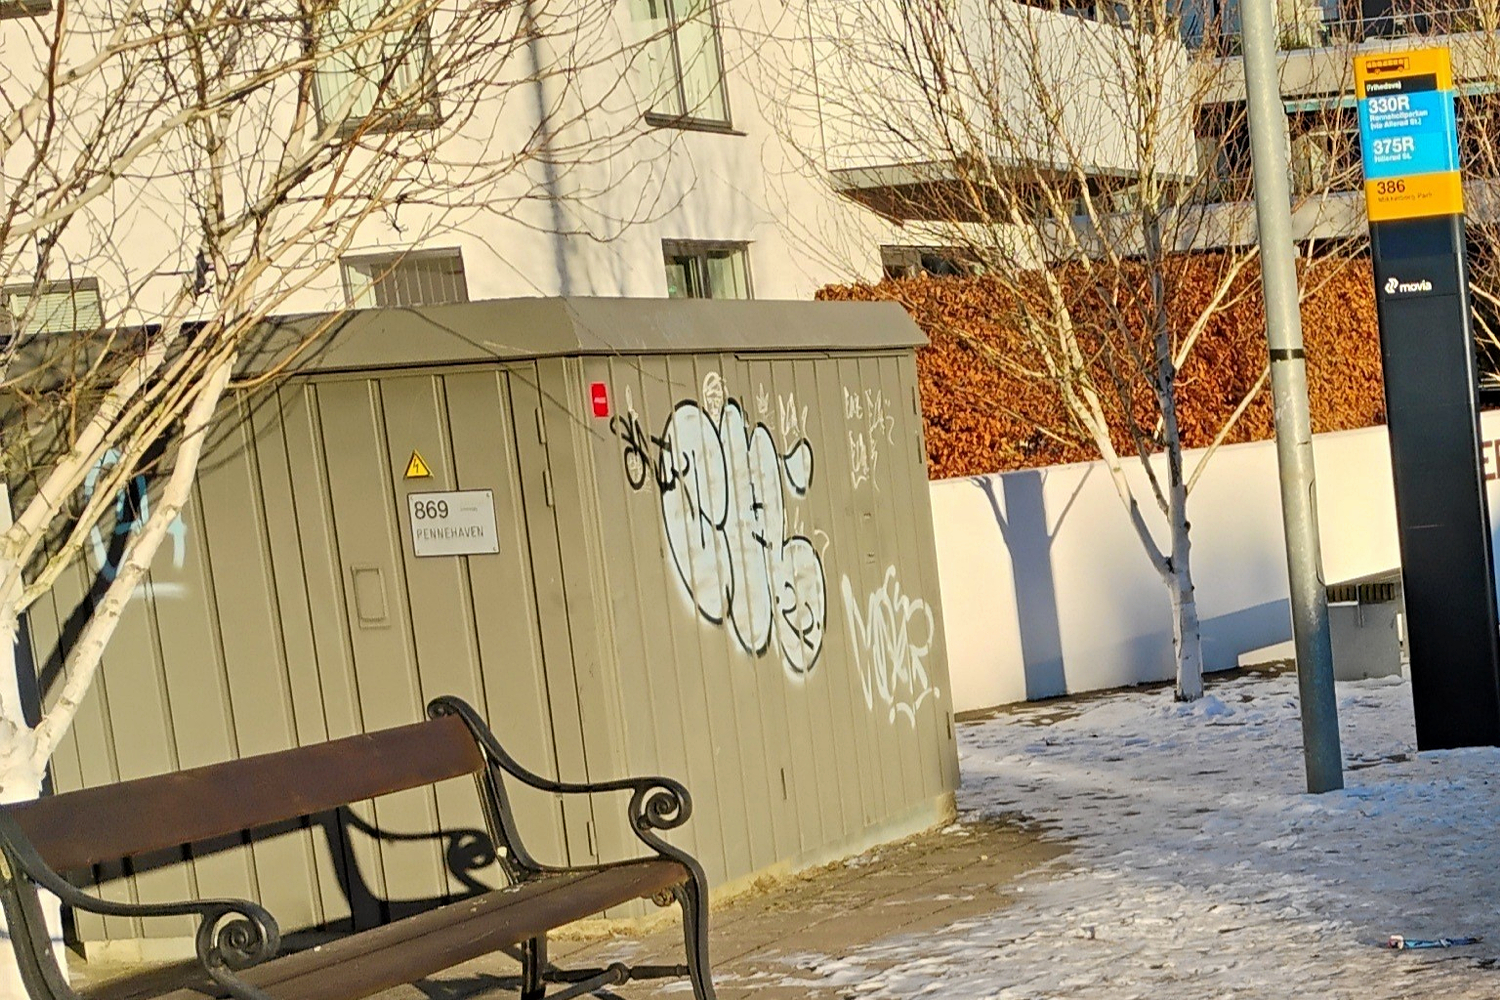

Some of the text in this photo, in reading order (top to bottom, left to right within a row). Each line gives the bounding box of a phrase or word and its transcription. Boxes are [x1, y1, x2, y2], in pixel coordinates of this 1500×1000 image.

[1368, 95, 1410, 114] 330R
[1374, 136, 1414, 155] 375R
[1377, 179, 1406, 195] 386
[1399, 279, 1433, 293] movia
[414, 500, 449, 520] 869
